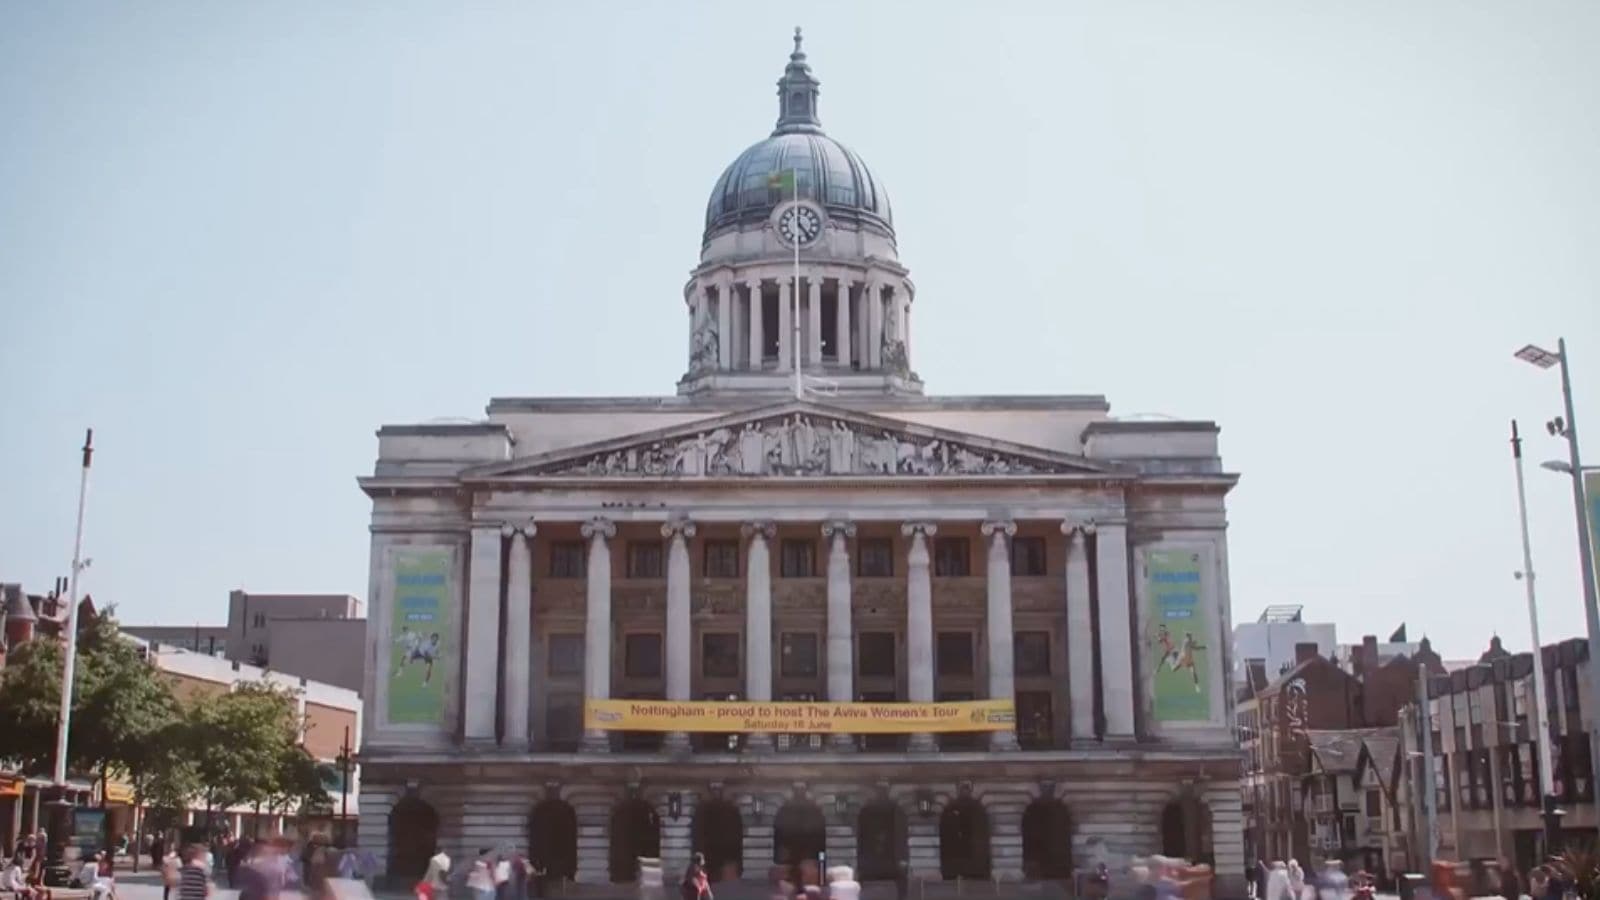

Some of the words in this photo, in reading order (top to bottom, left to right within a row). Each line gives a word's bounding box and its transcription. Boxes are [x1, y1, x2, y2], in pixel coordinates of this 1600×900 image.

[631, 704, 705, 717] Nottingham
[717, 706, 754, 718] proud
[759, 706, 771, 717] to
[775, 706, 803, 717] host
[807, 706, 830, 717] The
[833, 707, 867, 718] Aviva
[870, 706, 928, 718] Women's
[932, 706, 960, 717] Tour
[744, 719, 789, 729] Saturday
[808, 720, 832, 729] June
